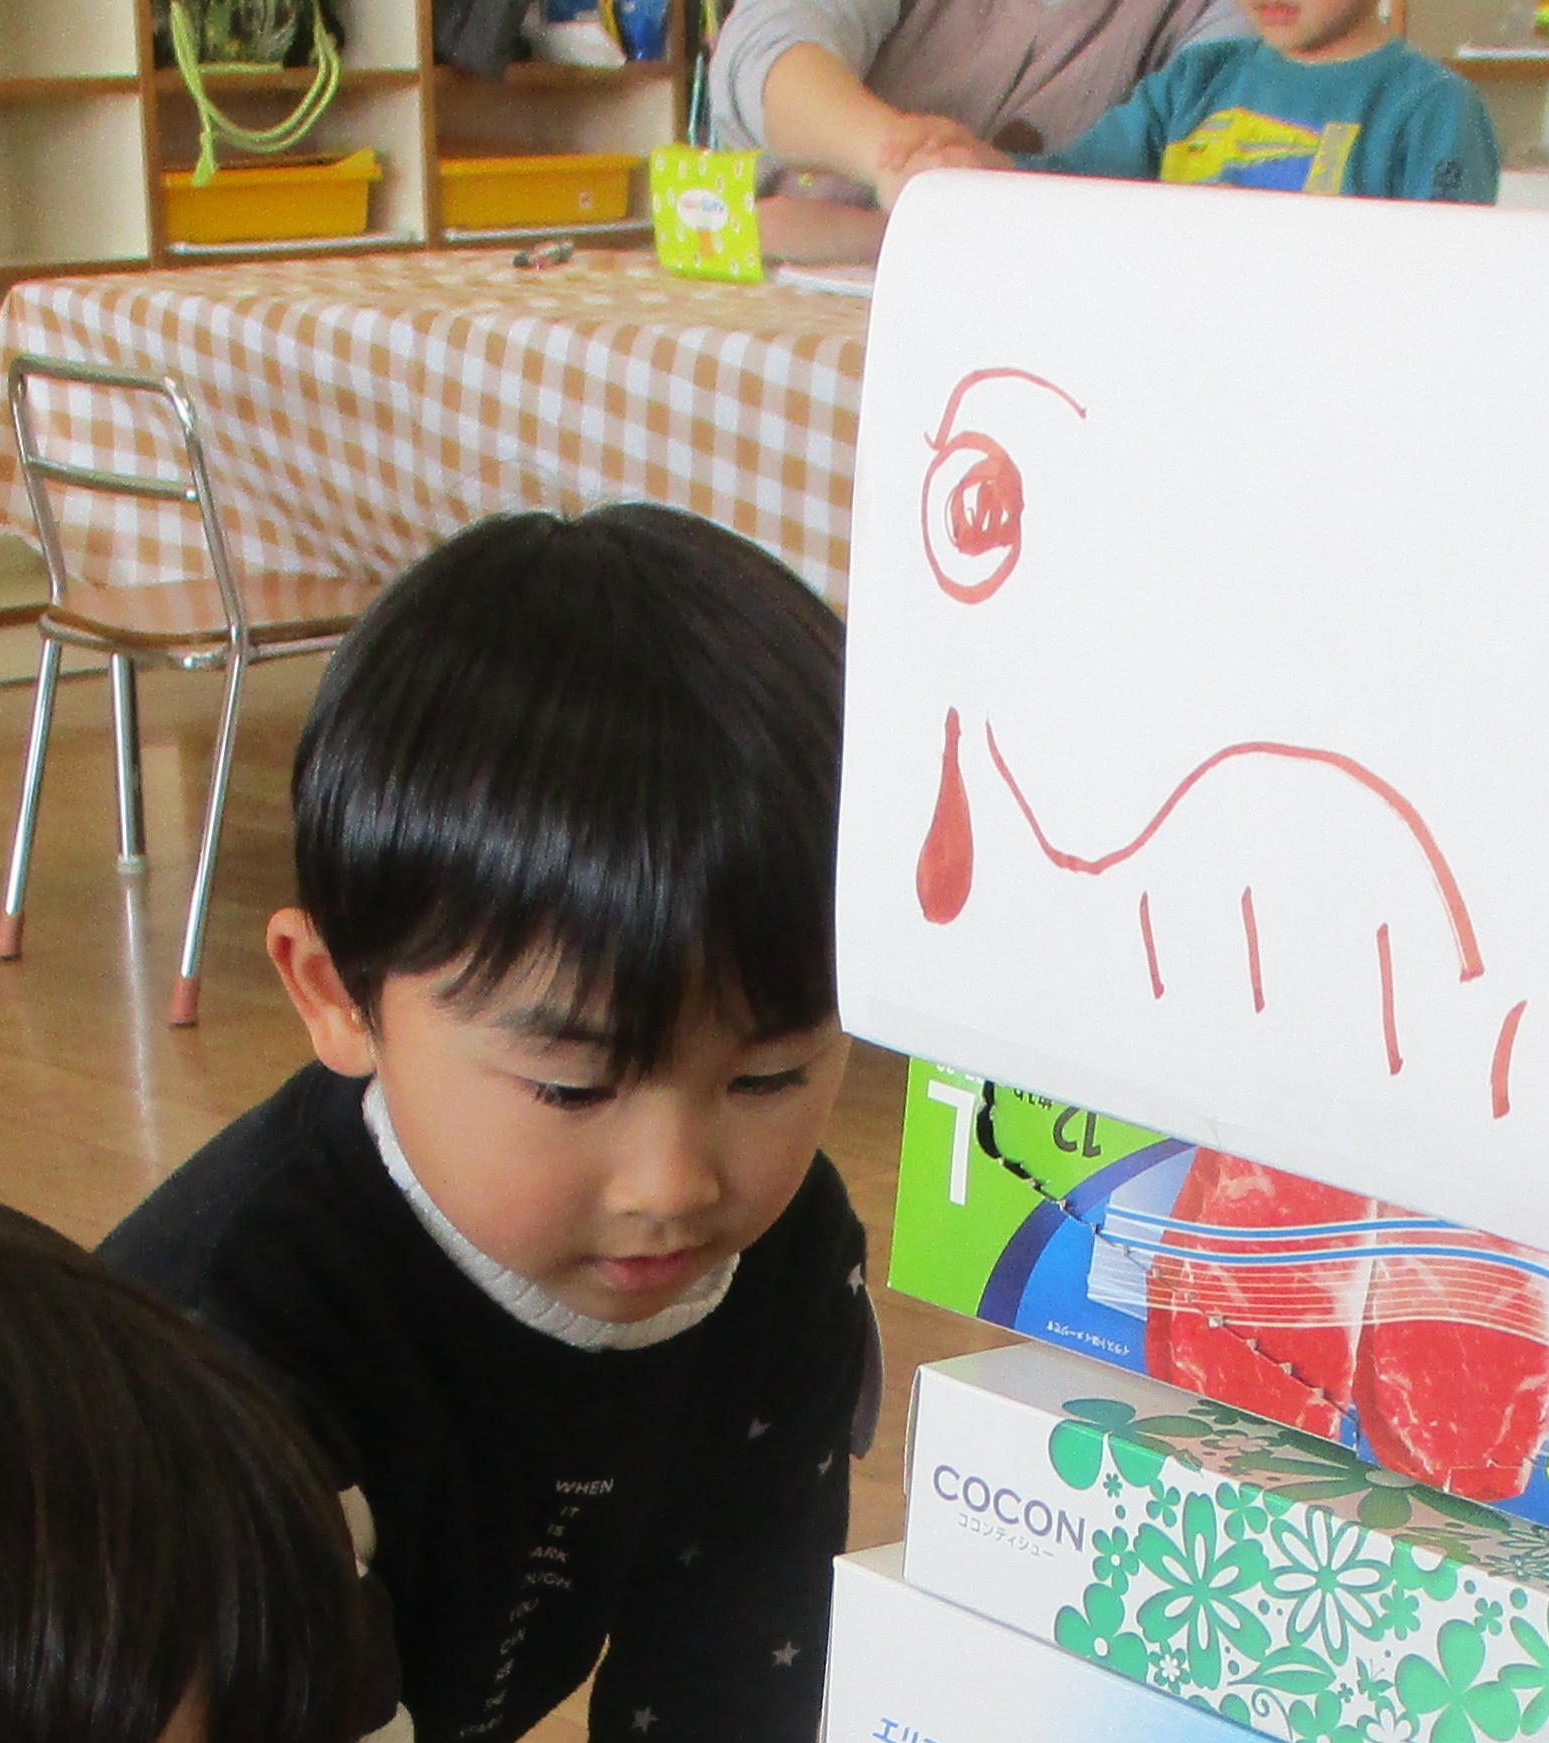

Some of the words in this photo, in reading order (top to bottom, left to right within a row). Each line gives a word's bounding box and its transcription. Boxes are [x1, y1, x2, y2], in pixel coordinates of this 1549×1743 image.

[927, 1079, 977, 1207] L
[555, 1477, 615, 1496] WHEN
[931, 1463, 1087, 1554] COCON
[956, 1510, 1056, 1560] ココンティシュー
